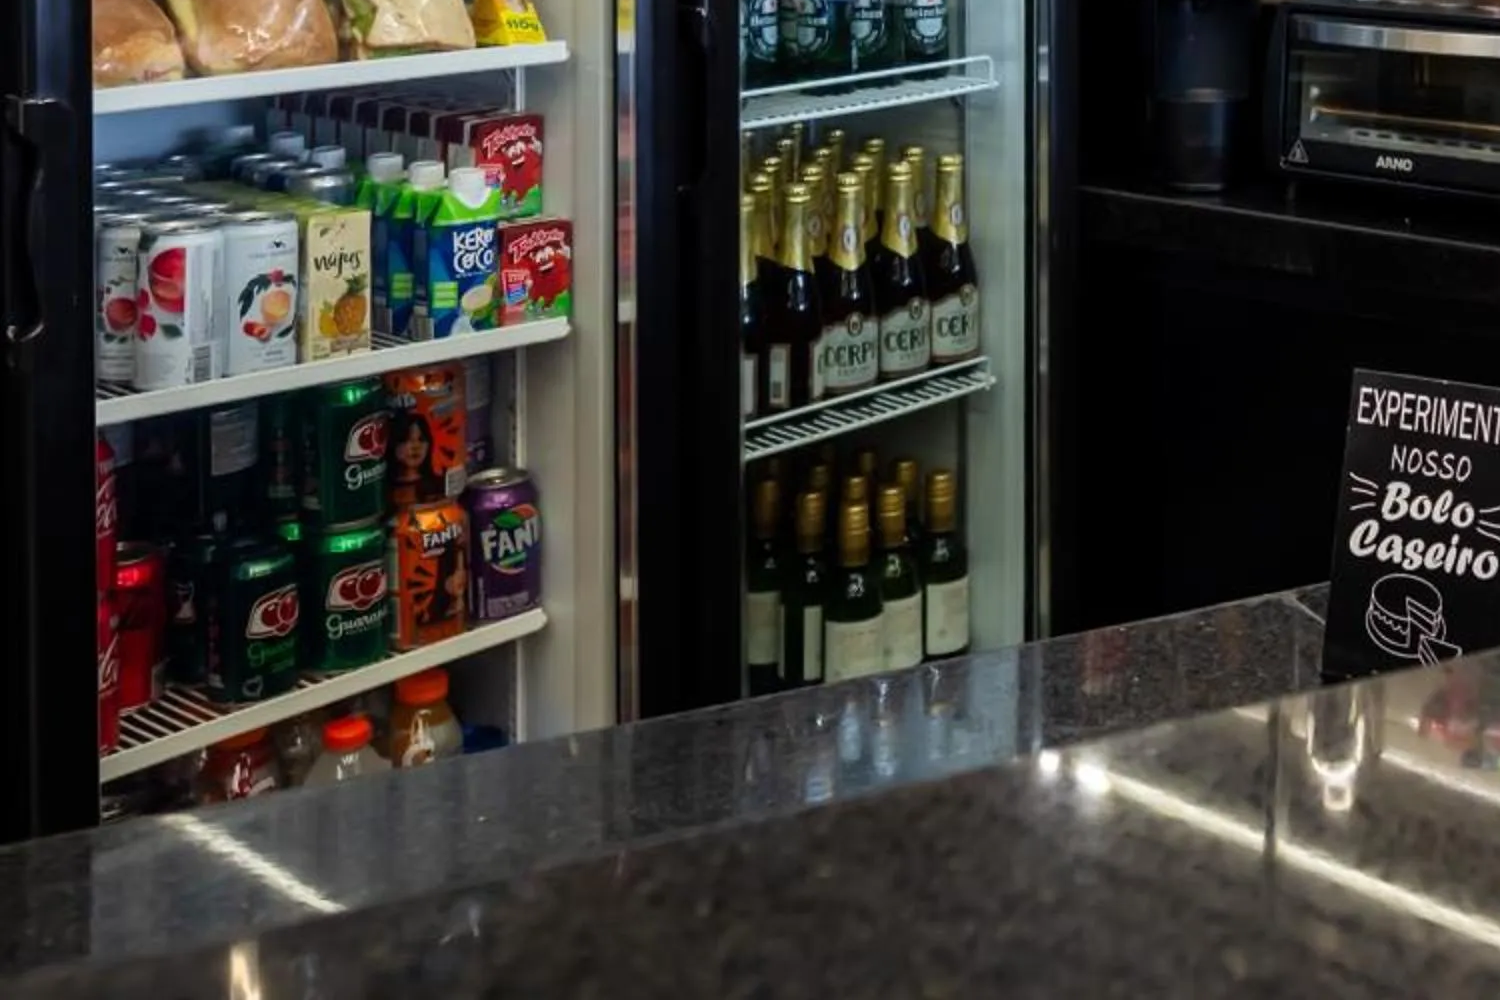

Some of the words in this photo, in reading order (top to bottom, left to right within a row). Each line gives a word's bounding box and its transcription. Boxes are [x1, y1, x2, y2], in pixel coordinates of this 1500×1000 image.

[1375, 155, 1413, 173] ARNO
[453, 227, 495, 252] KERO
[453, 249, 495, 273] COCO
[1390, 443, 1473, 483] NOSSO
[1380, 481, 1475, 528] Bolo
[1349, 518, 1499, 581] Caseiro
